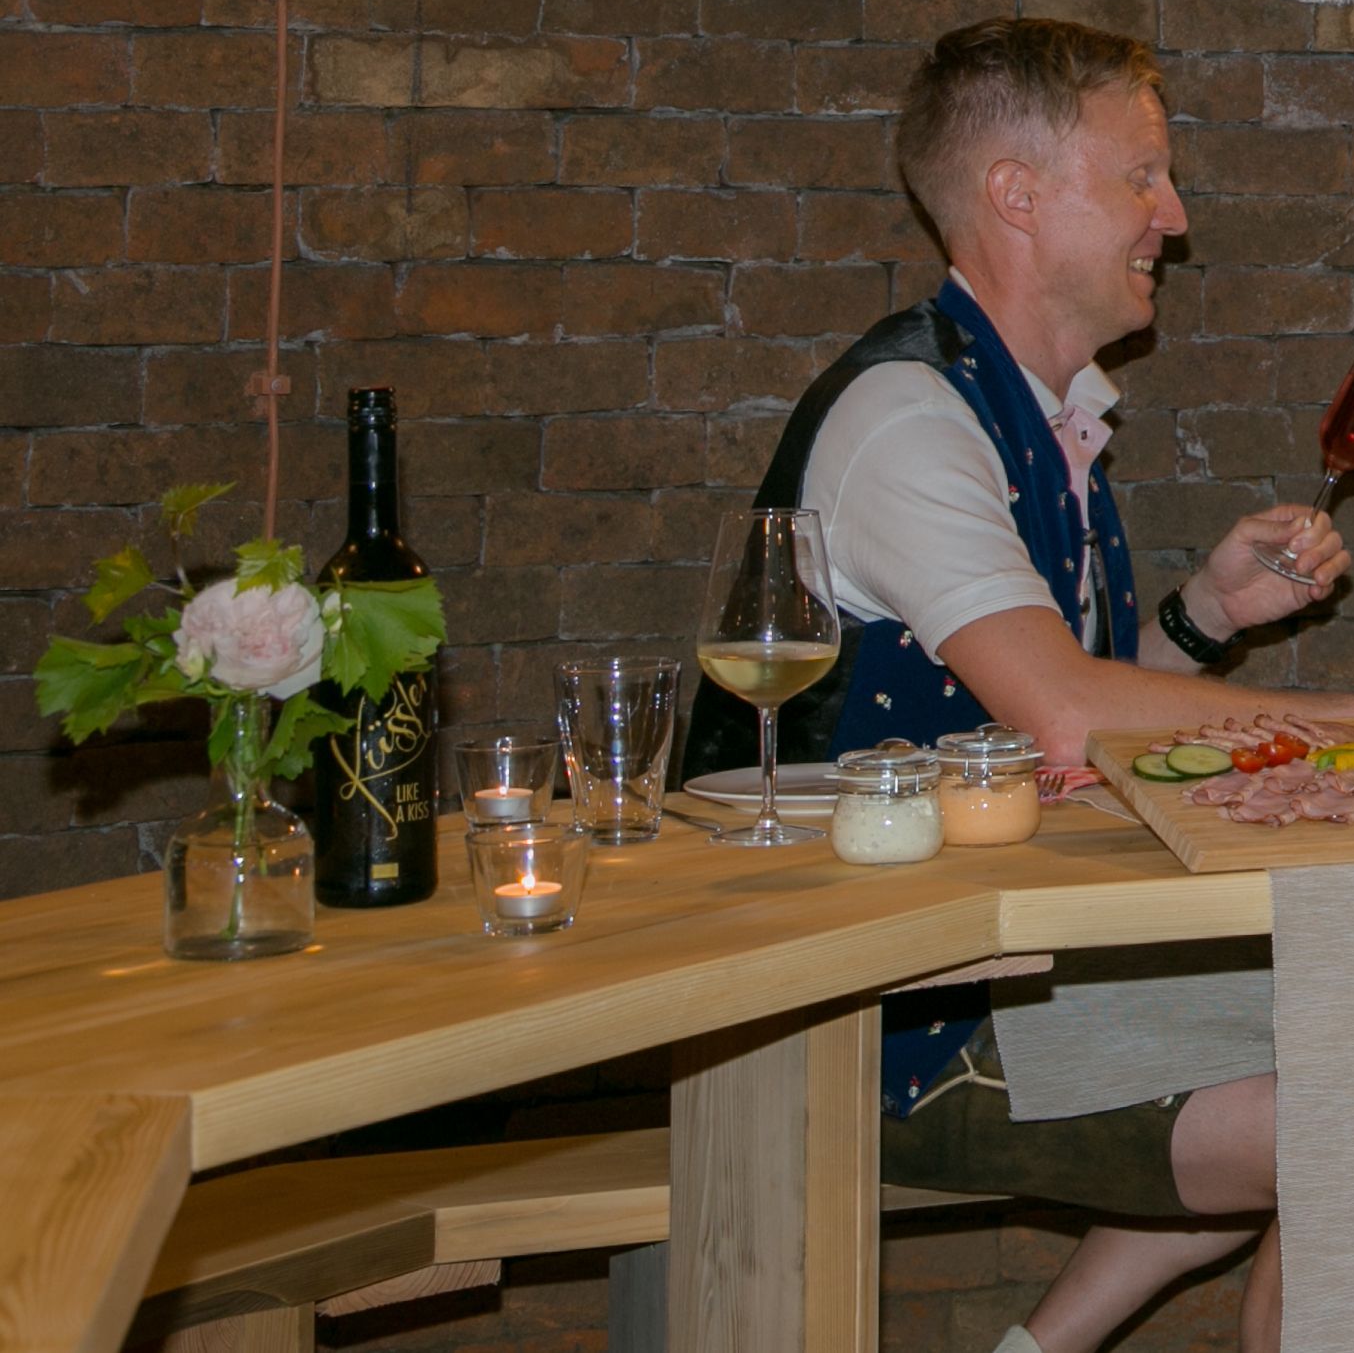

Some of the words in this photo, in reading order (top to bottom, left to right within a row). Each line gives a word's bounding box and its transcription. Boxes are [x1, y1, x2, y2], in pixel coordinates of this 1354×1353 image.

[396, 783, 419, 803] LIKE
[395, 804, 404, 823] A
[407, 800, 429, 821] KISS
